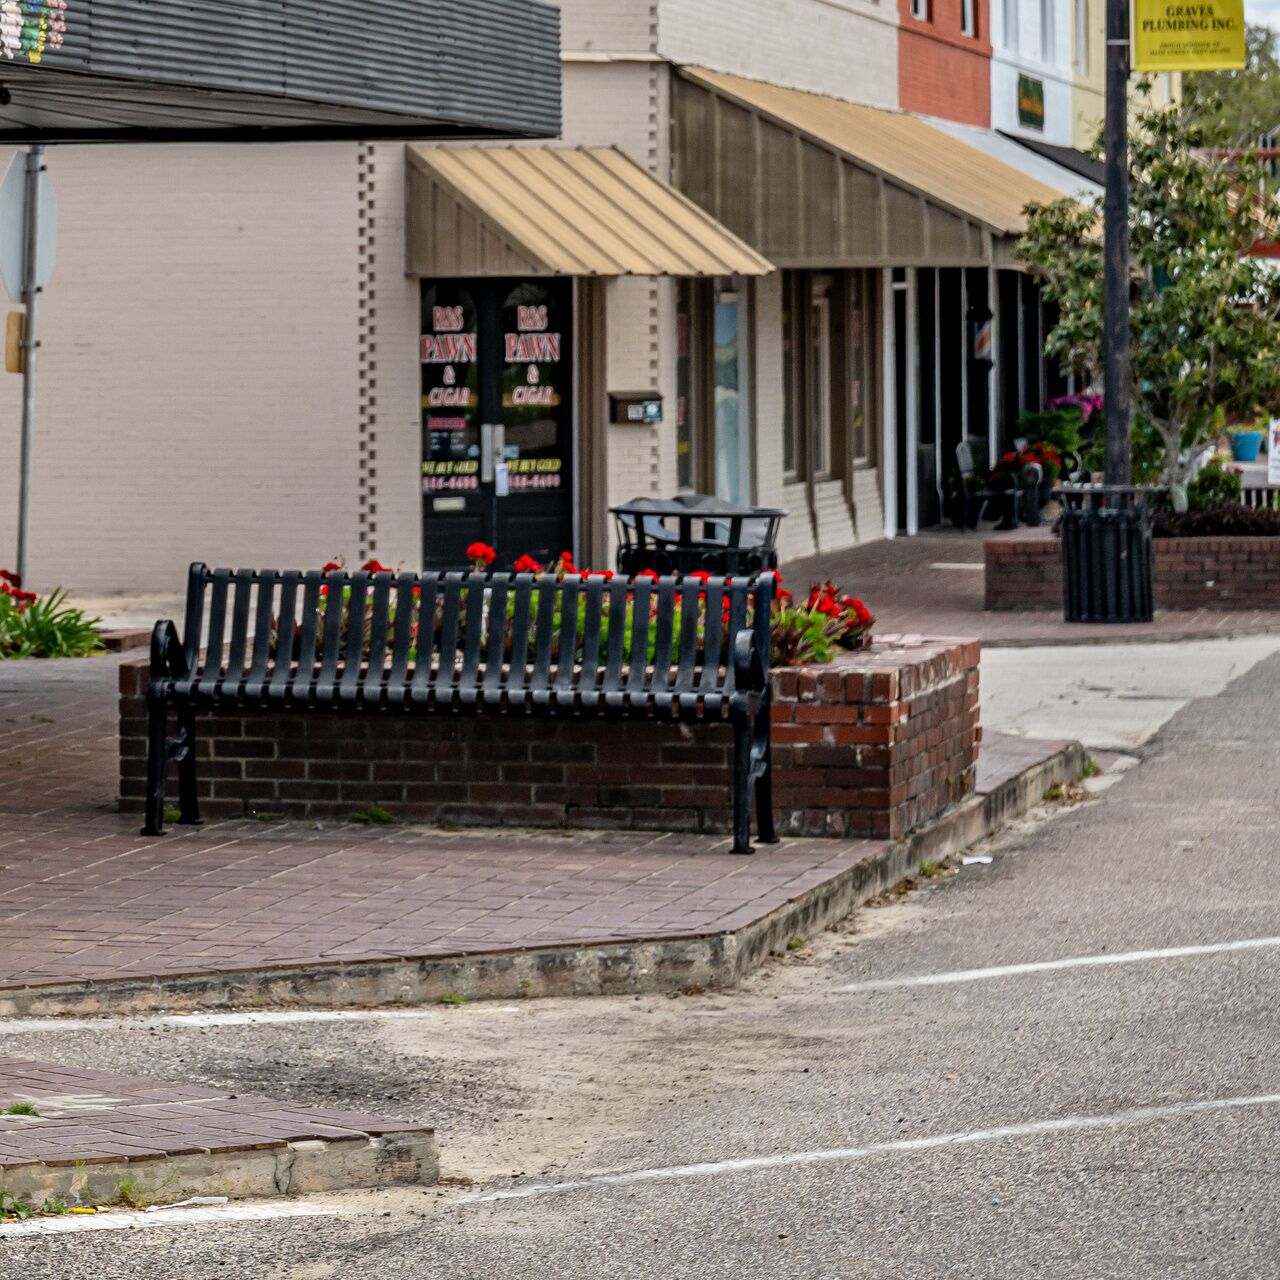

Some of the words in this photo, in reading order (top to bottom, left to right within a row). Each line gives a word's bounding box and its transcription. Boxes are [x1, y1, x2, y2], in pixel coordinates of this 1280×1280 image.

[1165, 5, 1214, 17] GRAVES
[1142, 19, 1208, 33] PLUMBING
[1211, 18, 1238, 32] INC.
[421, 333, 477, 363] PAWN
[504, 333, 561, 362] PAWN
[443, 365, 456, 385] &
[527, 364, 539, 384] &
[428, 387, 470, 406] CIGAR
[512, 385, 554, 404] CIGAR
